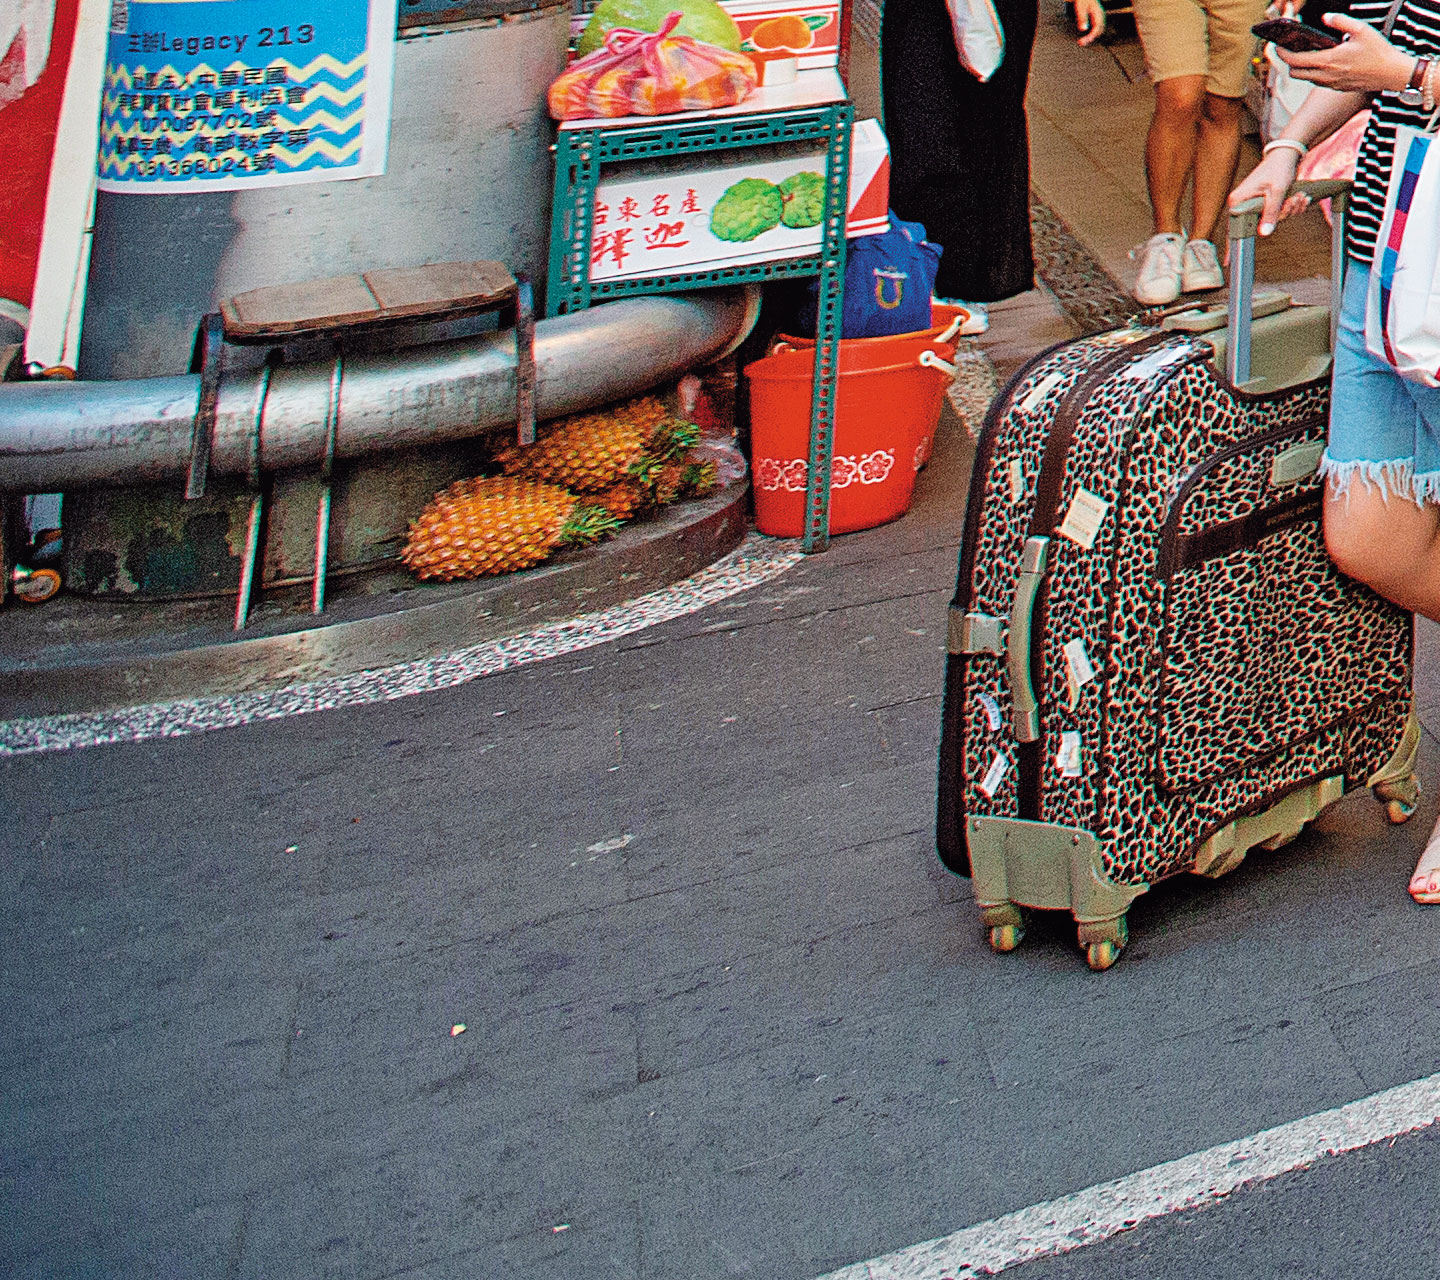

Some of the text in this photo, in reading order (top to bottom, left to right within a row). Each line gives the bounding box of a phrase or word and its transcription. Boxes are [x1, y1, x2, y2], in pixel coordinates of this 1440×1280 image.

[258, 25, 315, 47] 213
[595, 188, 702, 224] 台東名產
[590, 221, 689, 269] 釋迦
